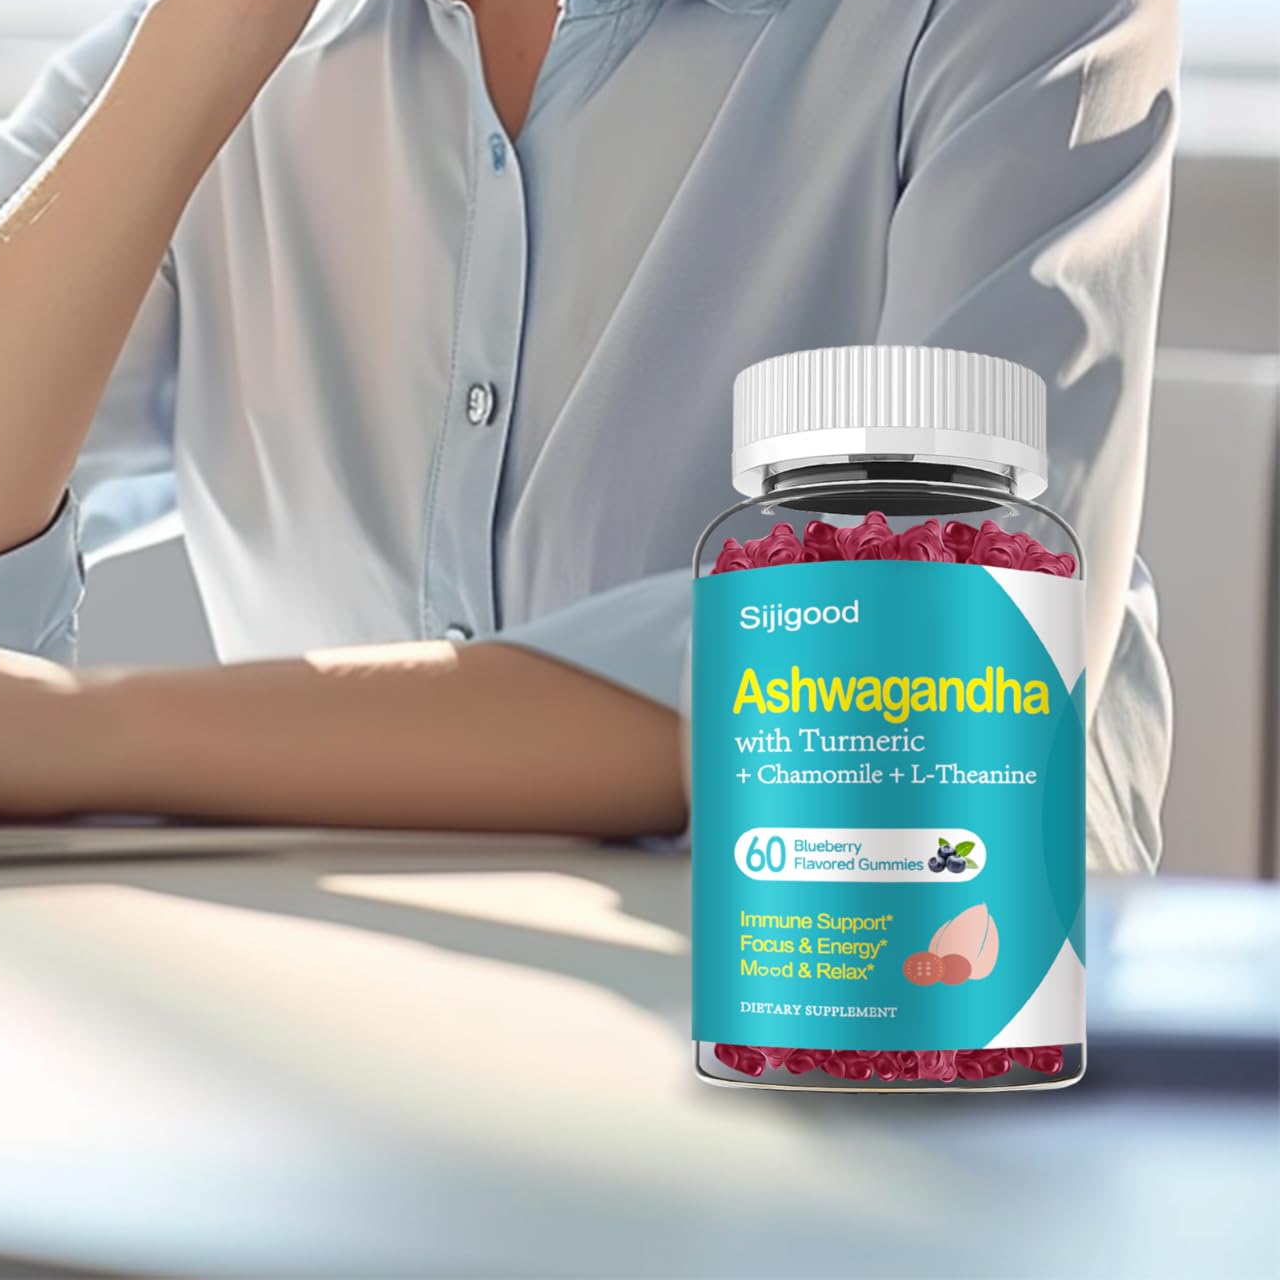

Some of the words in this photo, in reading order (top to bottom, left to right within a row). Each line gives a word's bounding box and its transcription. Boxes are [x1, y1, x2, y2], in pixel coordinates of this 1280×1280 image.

[740, 600, 860, 633] Sijigood
[732, 665, 1050, 724] Ashwagandha
[735, 729, 792, 753] with
[799, 728, 925, 753] Turmeric
[757, 764, 883, 784] Chamomile
[911, 764, 1037, 784] L-Theanine
[745, 835, 786, 873] 60
[794, 839, 862, 856] Blueberry
[794, 857, 855, 871] Flavored
[858, 858, 924, 872] Gummies
[740, 911, 813, 929] Immune
[740, 935, 794, 954] Focus
[799, 936, 813, 954] &
[740, 960, 793, 978] Mood
[798, 961, 812, 978] &
[740, 1001, 802, 1016] DIETARY
[805, 1004, 898, 1018] SUPPLEMENT
